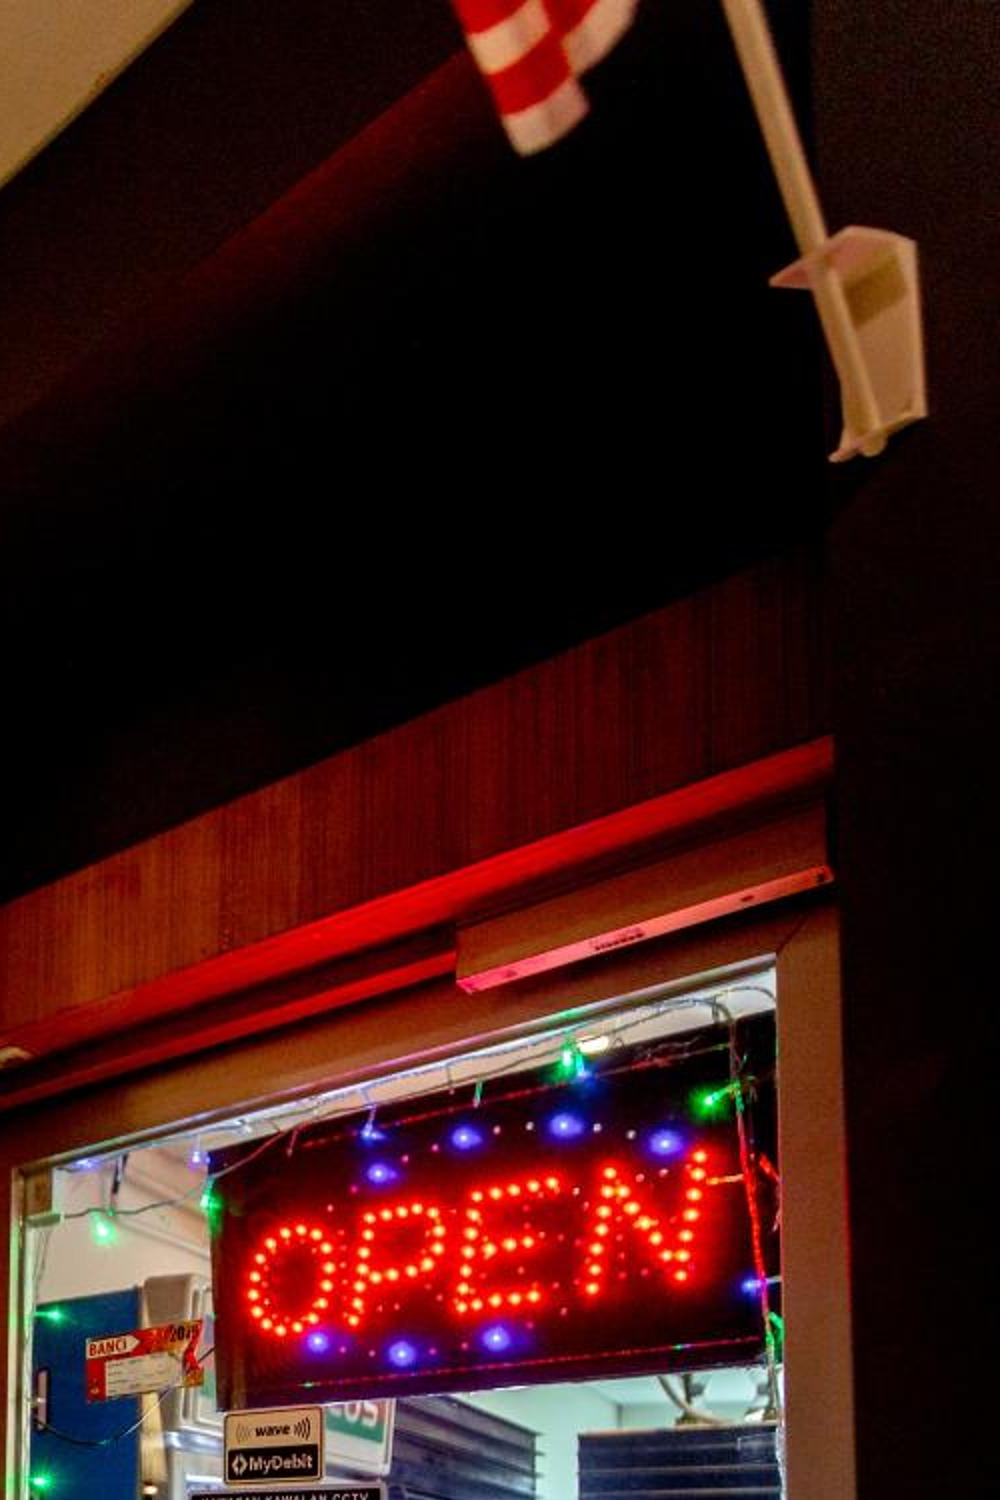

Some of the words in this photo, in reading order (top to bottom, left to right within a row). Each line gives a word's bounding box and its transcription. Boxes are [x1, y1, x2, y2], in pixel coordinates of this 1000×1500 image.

[247, 1150, 708, 1336] OPEN
[89, 1339, 127, 1356] BANCI
[255, 1424, 291, 1438] wave
[249, 1453, 313, 1474] MyDebit
